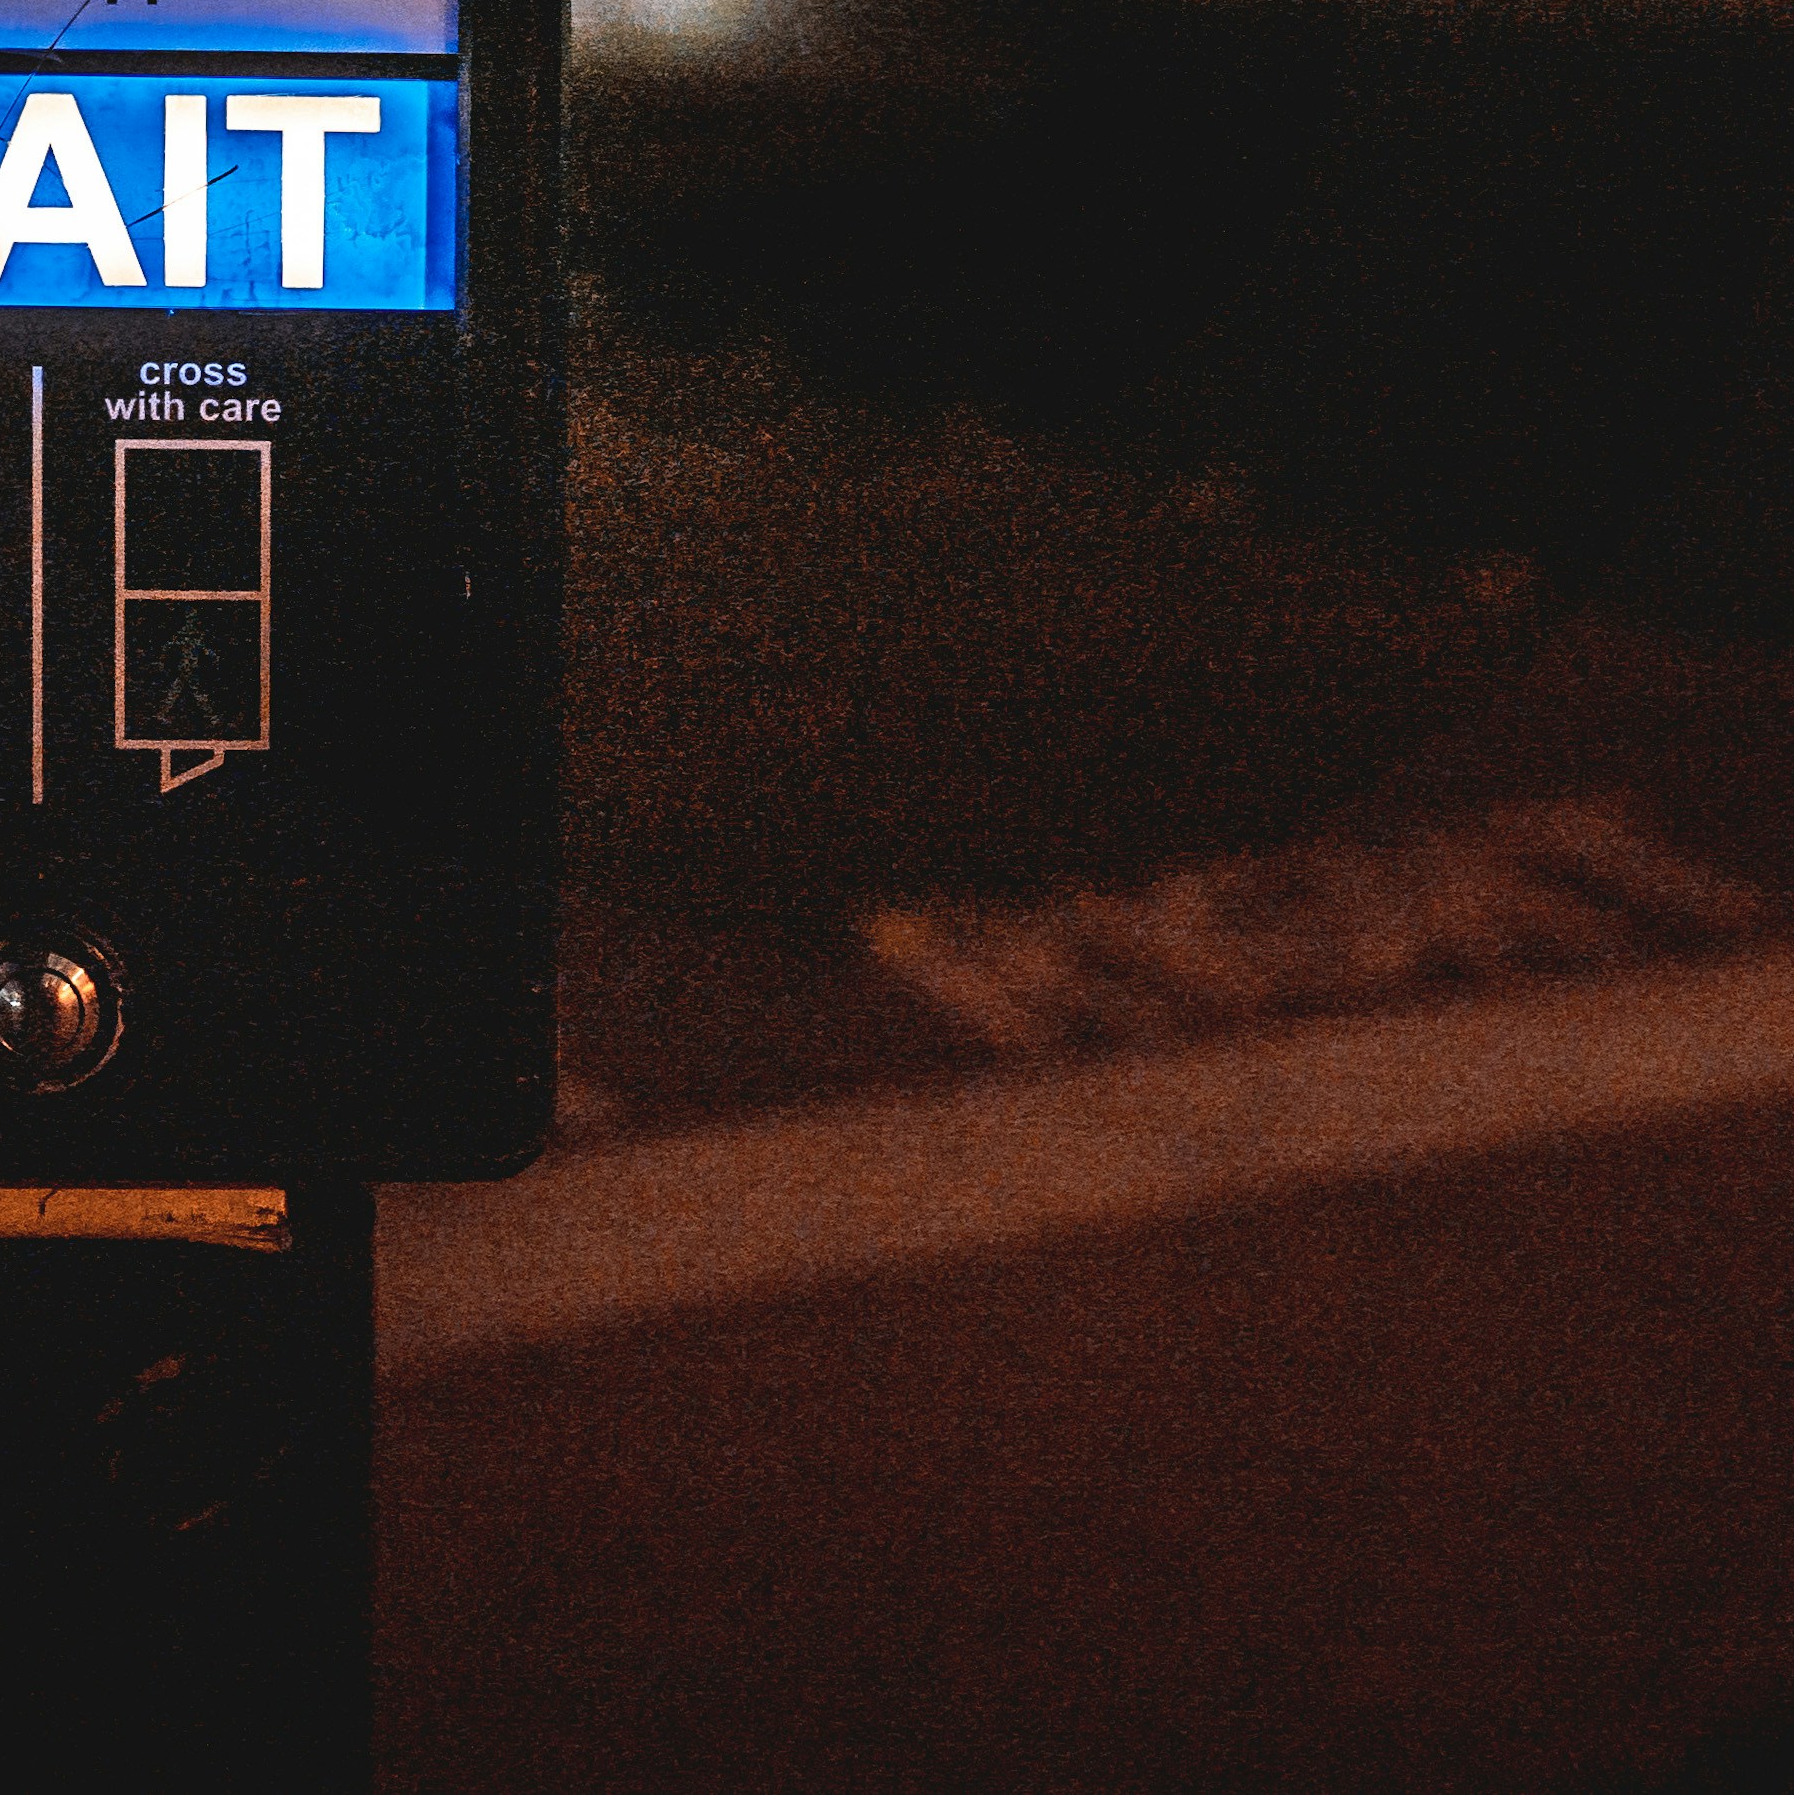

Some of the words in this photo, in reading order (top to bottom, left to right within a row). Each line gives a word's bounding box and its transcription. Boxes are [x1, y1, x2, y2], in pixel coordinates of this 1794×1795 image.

[139, 357, 247, 386] cross
[105, 390, 185, 423] with
[198, 395, 283, 424] care
